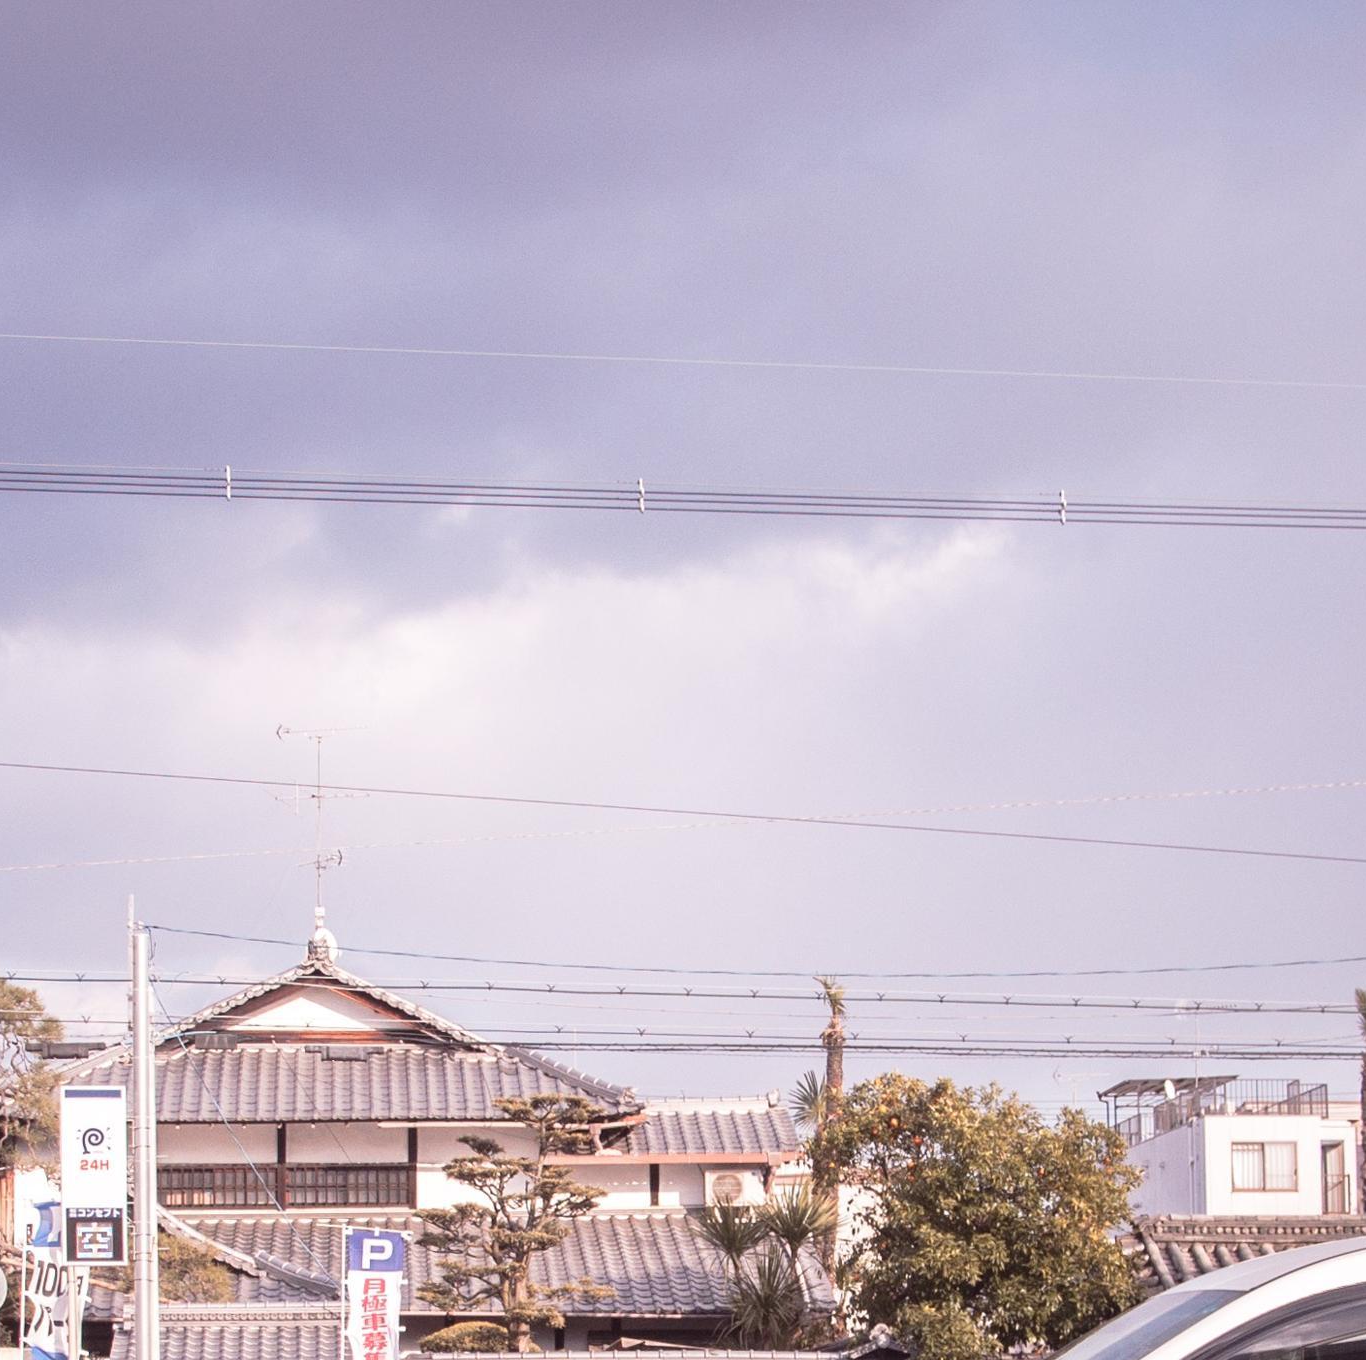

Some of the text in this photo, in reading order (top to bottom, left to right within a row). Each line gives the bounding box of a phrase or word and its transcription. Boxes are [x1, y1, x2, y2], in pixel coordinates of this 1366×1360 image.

[80, 1159, 109, 1171] 24H
[76, 1222, 114, 1259] 空
[361, 1238, 394, 1270] P
